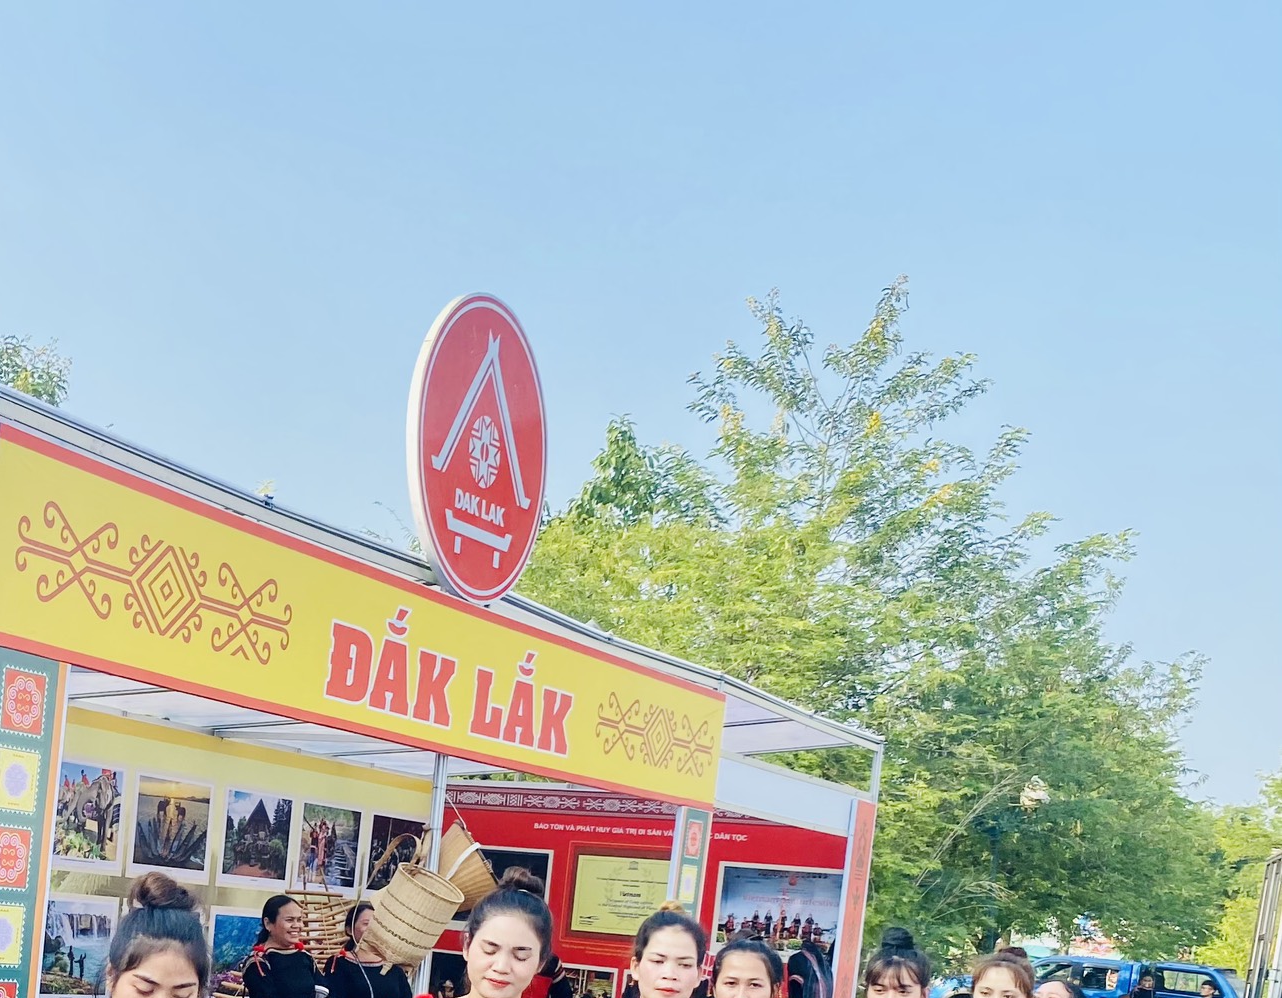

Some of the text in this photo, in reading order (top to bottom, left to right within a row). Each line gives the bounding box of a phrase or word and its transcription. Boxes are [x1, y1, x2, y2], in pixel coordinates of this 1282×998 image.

[480, 499, 506, 528] LAK
[324, 606, 575, 757] ĐẮK LẮK
